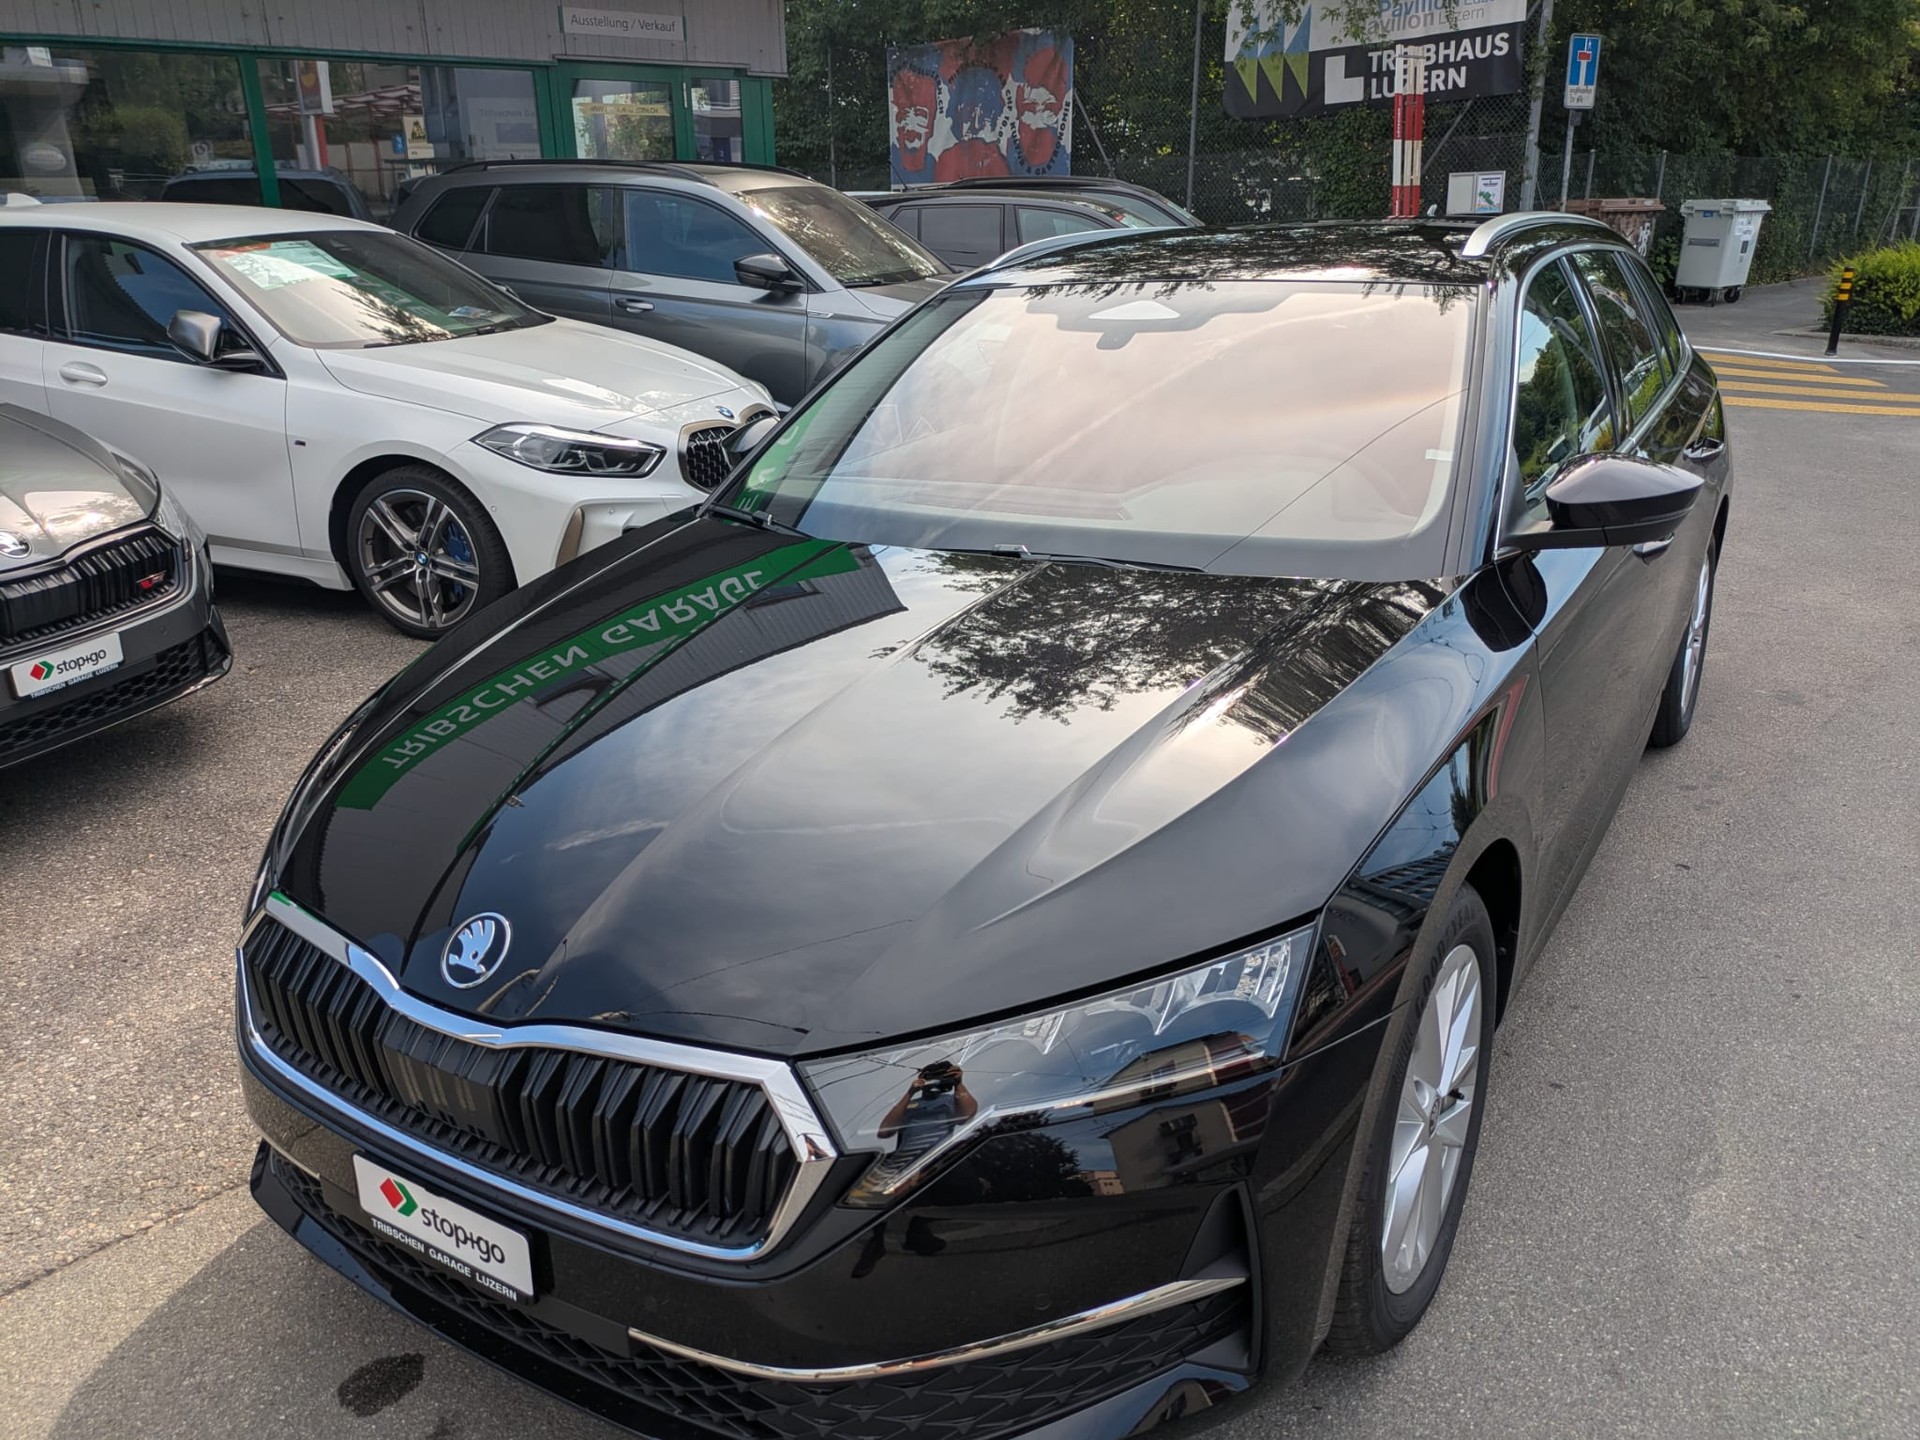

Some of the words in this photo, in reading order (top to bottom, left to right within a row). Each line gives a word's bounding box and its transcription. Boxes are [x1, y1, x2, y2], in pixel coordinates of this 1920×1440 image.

[570, 14, 629, 32] Ausstellung
[631, 18, 637, 30] /
[638, 19, 676, 32] Verkauf
[1364, 12, 1435, 34] avillon
[1439, 8, 1484, 25] Lzern
[1368, 32, 1510, 73] TRBHAUS
[1371, 66, 1467, 100] LUERN
[56, 649, 107, 675] stop+go
[420, 1207, 506, 1265] stop+go
[371, 1217, 426, 1253] TRIBSCHEN
[428, 1249, 472, 1278] GARAGE
[475, 1272, 518, 1302] LUZERN
